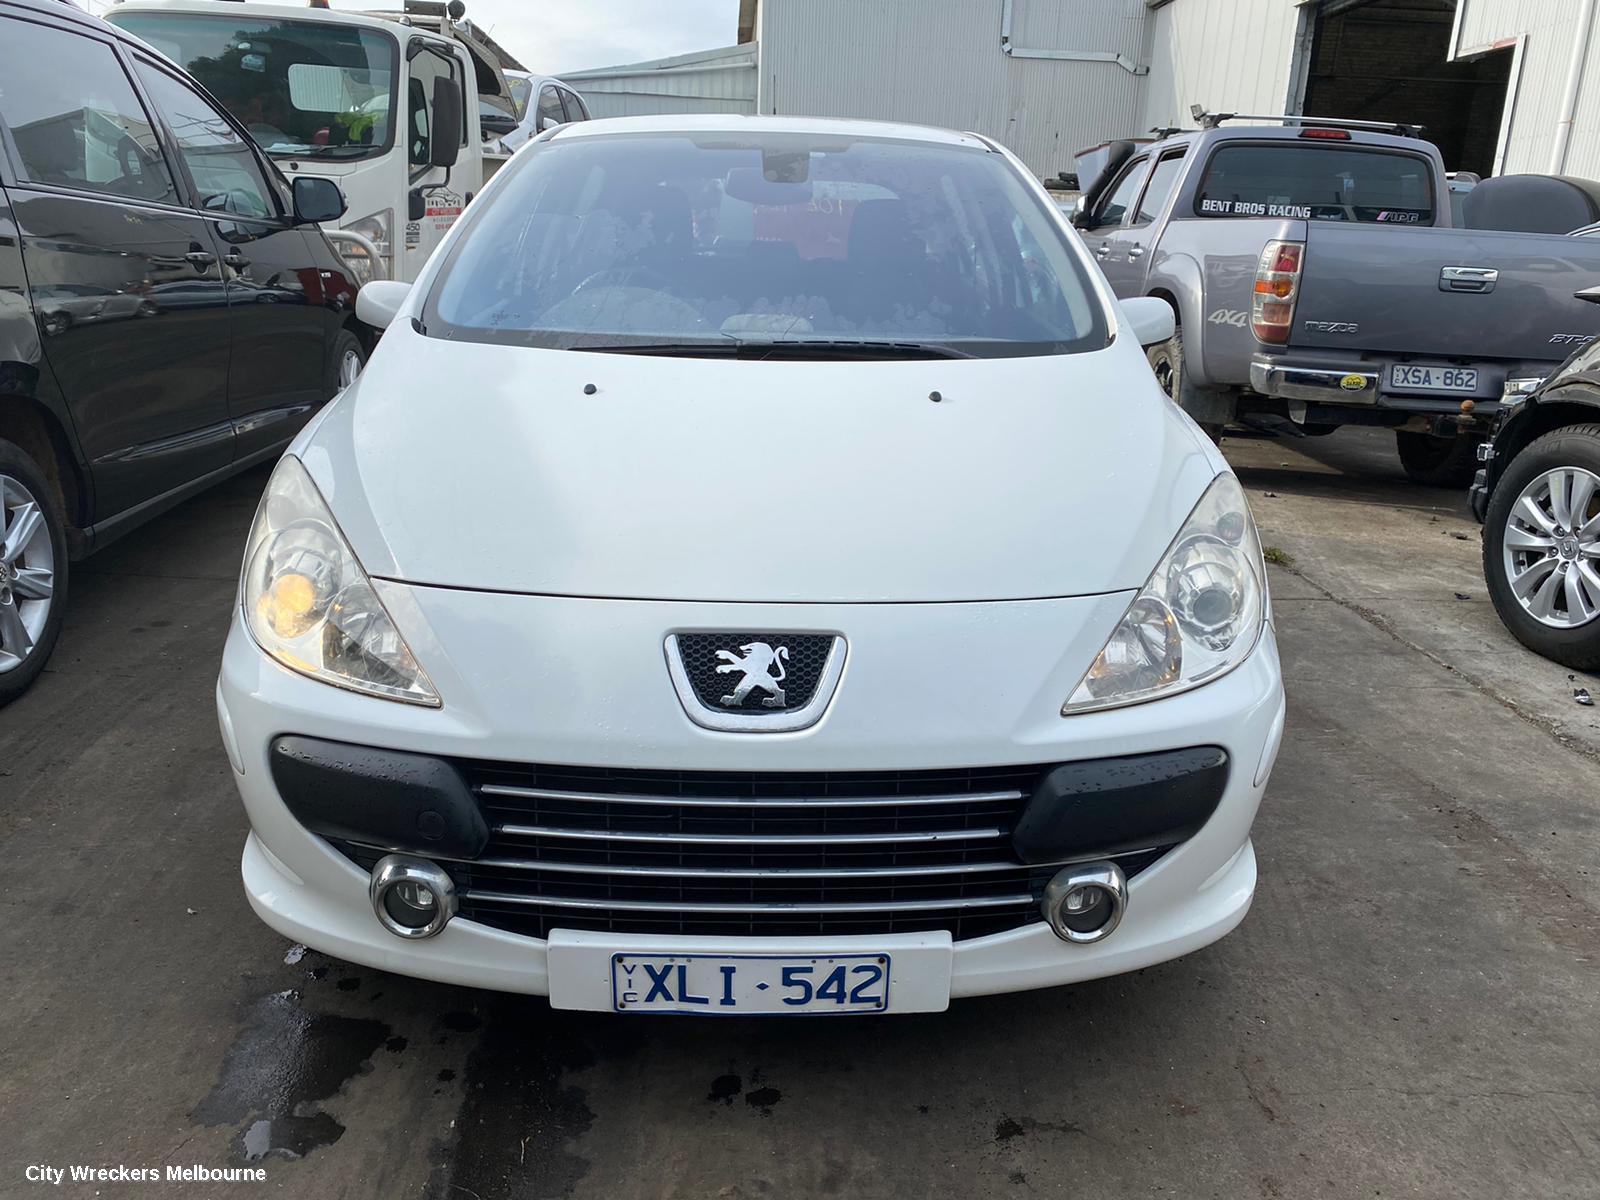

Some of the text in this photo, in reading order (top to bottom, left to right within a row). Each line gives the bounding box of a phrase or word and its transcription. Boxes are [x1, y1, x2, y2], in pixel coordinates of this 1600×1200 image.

[1202, 200, 1312, 219] BENT BROS RACING
[406, 222, 420, 232] 450
[622, 964, 638, 1003] VIC
